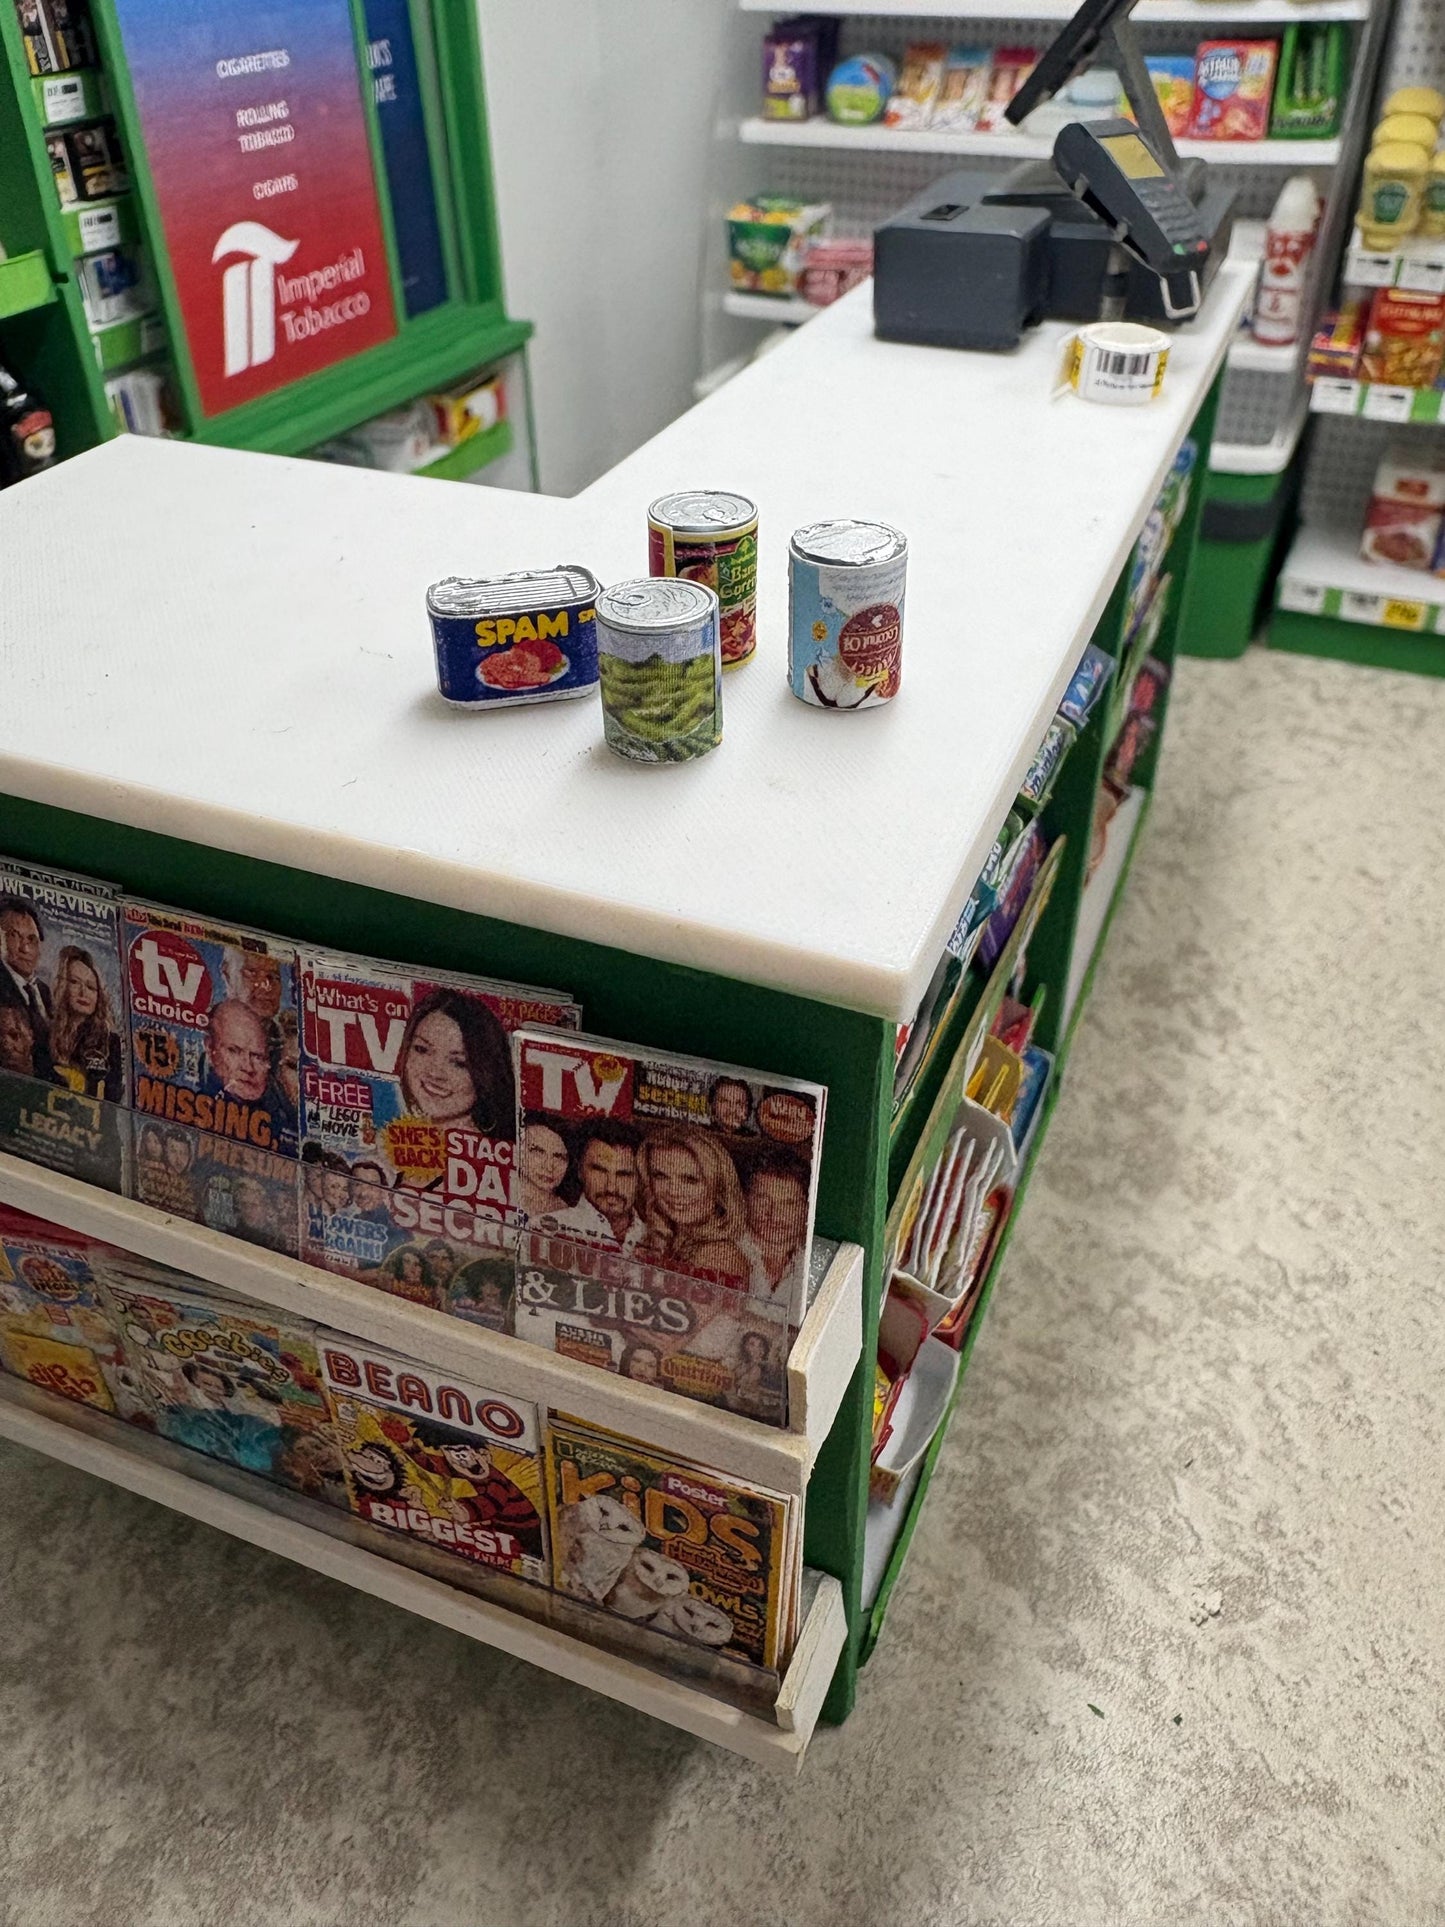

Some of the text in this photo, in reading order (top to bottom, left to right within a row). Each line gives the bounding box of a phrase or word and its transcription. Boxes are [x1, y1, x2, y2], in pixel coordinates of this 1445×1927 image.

[277, 247, 365, 305] Imperial
[280, 291, 371, 343] Tobacco
[475, 611, 569, 648] SPAM
[32, 884, 117, 920] PREVIEW
[134, 938, 206, 1006] tv
[316, 984, 379, 1012] What's
[318, 1005, 408, 1075] TV
[318, 1079, 371, 1108] FREE
[525, 1047, 629, 1119] TV
[19, 1107, 104, 1152] LEGACY
[324, 1348, 525, 1440] BEANO
[368, 1501, 516, 1556] BIGGEST
